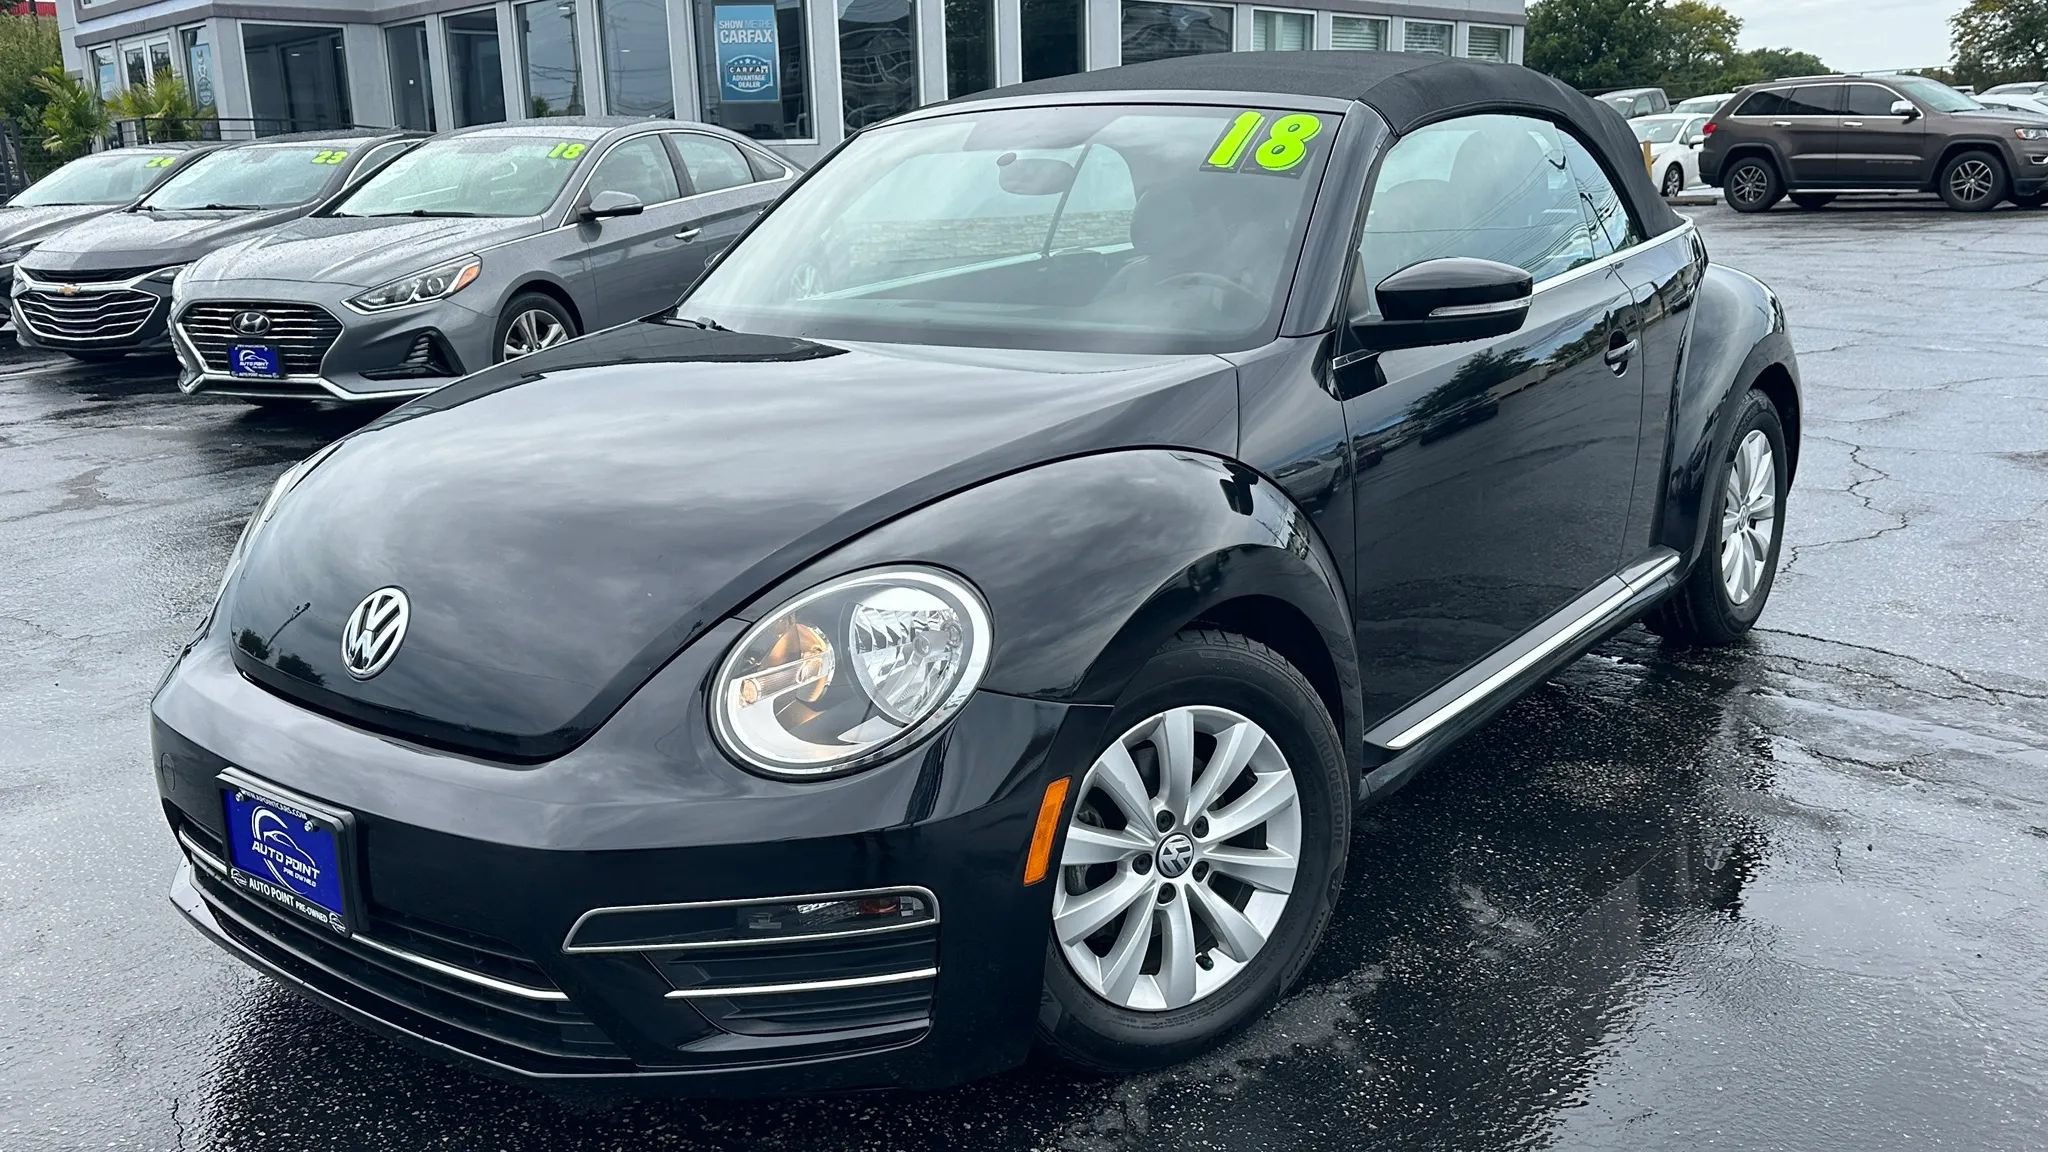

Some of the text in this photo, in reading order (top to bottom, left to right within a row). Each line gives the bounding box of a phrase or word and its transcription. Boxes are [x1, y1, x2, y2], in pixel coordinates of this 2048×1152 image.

[719, 20, 744, 29] SHOW
[720, 29, 773, 44] CARFAX
[729, 65, 768, 73] CARFAX
[1207, 108, 1322, 171] 18
[311, 150, 348, 164] 23
[547, 142, 586, 159] 18
[251, 840, 321, 880] AUTO POINT
[282, 866, 317, 888] PRE OWNED
[249, 877, 329, 924] AUTO POINT PRE-OWNED
